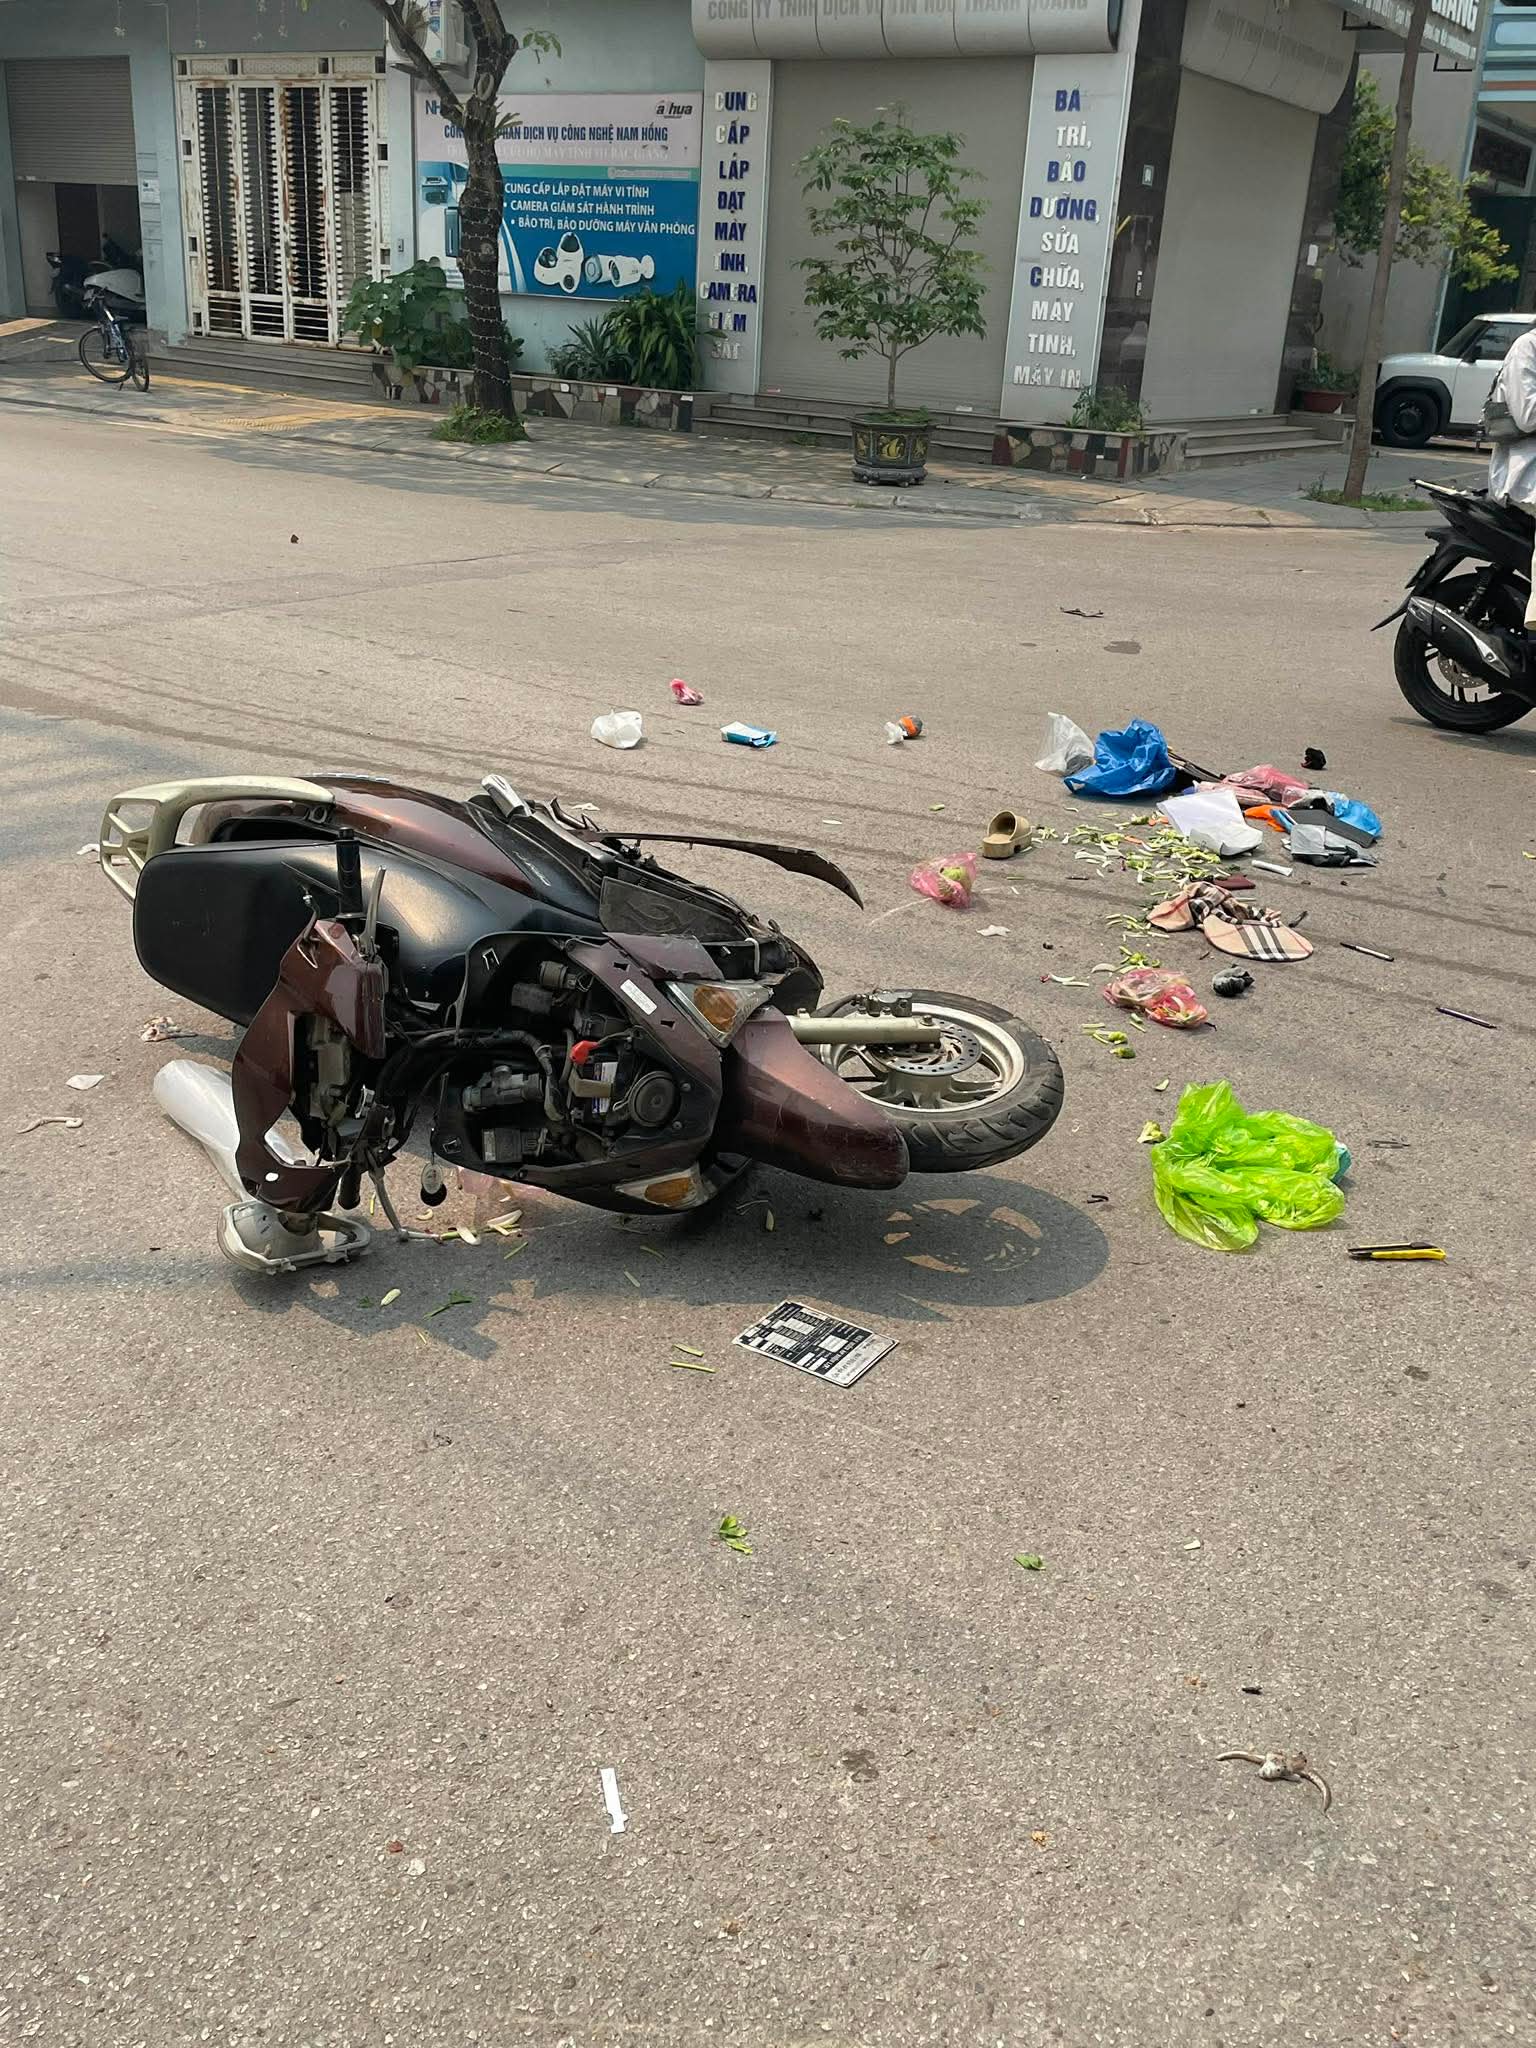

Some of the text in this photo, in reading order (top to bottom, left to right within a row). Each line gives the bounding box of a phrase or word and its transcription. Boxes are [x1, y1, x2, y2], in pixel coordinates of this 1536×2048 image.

[714, 91, 758, 111] CUNG
[523, 126, 545, 143] DỊCH
[547, 126, 559, 144] VỤ
[561, 123, 586, 141] CÔNG
[588, 123, 614, 144] NGHỆ
[616, 126, 639, 141] NAM
[716, 117, 750, 144] CẤP
[1047, 153, 1087, 183] BẢO
[504, 182, 531, 194] CUNG
[532, 181, 551, 195] CẤP
[593, 184, 614, 197] MÁY
[615, 186, 625, 197] VI
[627, 184, 650, 198] TÍNH
[510, 200, 655, 216] CAMERA GIÁM SÁT HÀNH TRÌNH
[518, 214, 696, 235] BẢO TRÌ, BẢO DƯỠNG MÁY VĂN PHÒNG
[1040, 226, 1080, 255] SỬA
[1030, 262, 1085, 292] CHỮA,
[699, 281, 758, 303] CAMERA
[1059, 367, 1082, 389] IN
